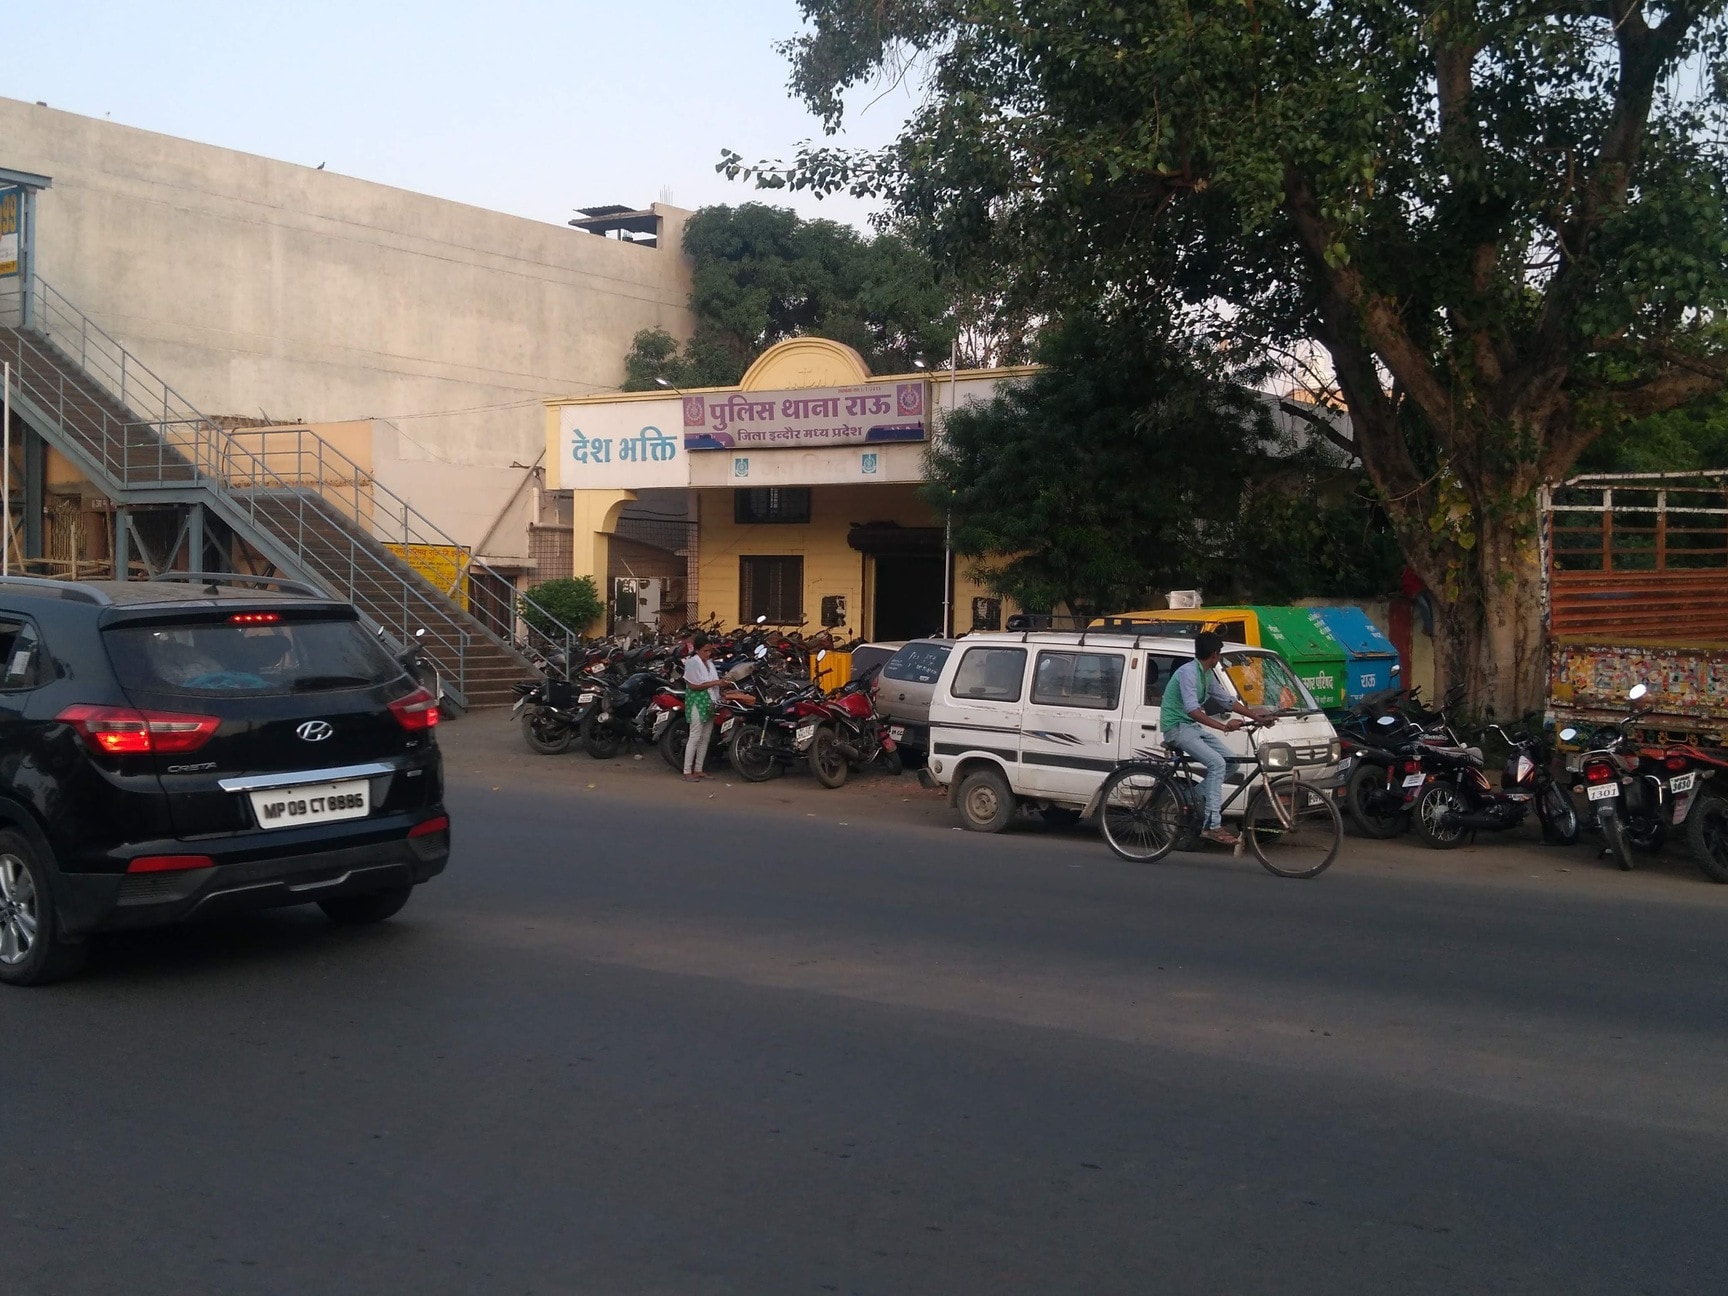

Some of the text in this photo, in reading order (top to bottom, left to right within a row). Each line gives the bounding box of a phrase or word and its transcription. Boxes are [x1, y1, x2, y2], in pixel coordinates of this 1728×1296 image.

[0, 193, 17, 234] 99
[709, 394, 892, 432] पुलिस थाना राऊ
[571, 425, 678, 464] देश भक्ति
[737, 428, 767, 441] जिला
[768, 426, 801, 442] इन्दौर
[803, 427, 829, 439] मध्य
[832, 423, 863, 438] प्रदेश
[263, 802, 286, 820] MP
[287, 799, 307, 816] 09
[310, 797, 326, 814] CT
[1591, 788, 1617, 799] 1301
